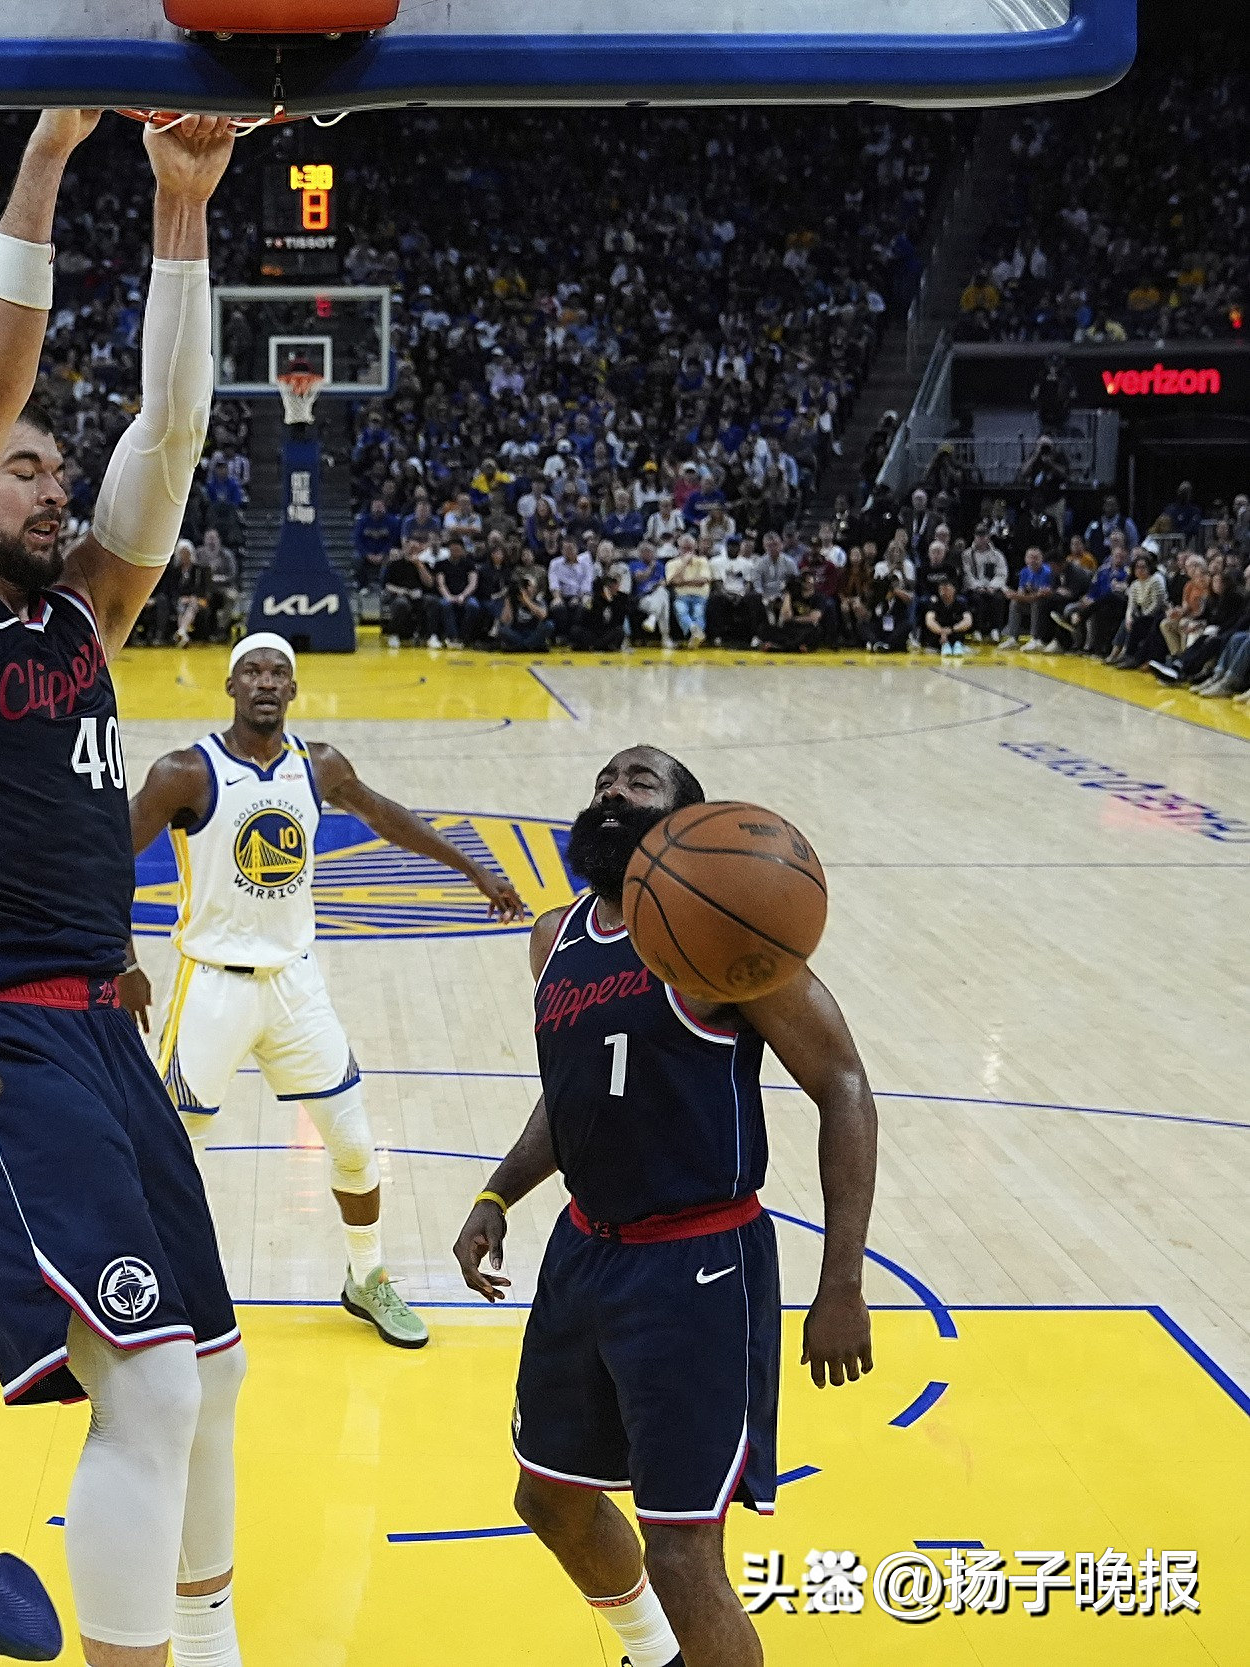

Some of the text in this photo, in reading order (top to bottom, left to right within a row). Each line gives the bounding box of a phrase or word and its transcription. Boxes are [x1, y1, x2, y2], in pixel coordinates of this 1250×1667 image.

[302, 189, 329, 230] 8
[1102, 363, 1221, 395] verizon
[71, 716, 124, 789] 40
[233, 799, 272, 827] GOLDEN
[279, 826, 299, 849] 10
[535, 966, 652, 1033] Clippers
[604, 1033, 627, 1096] 1
